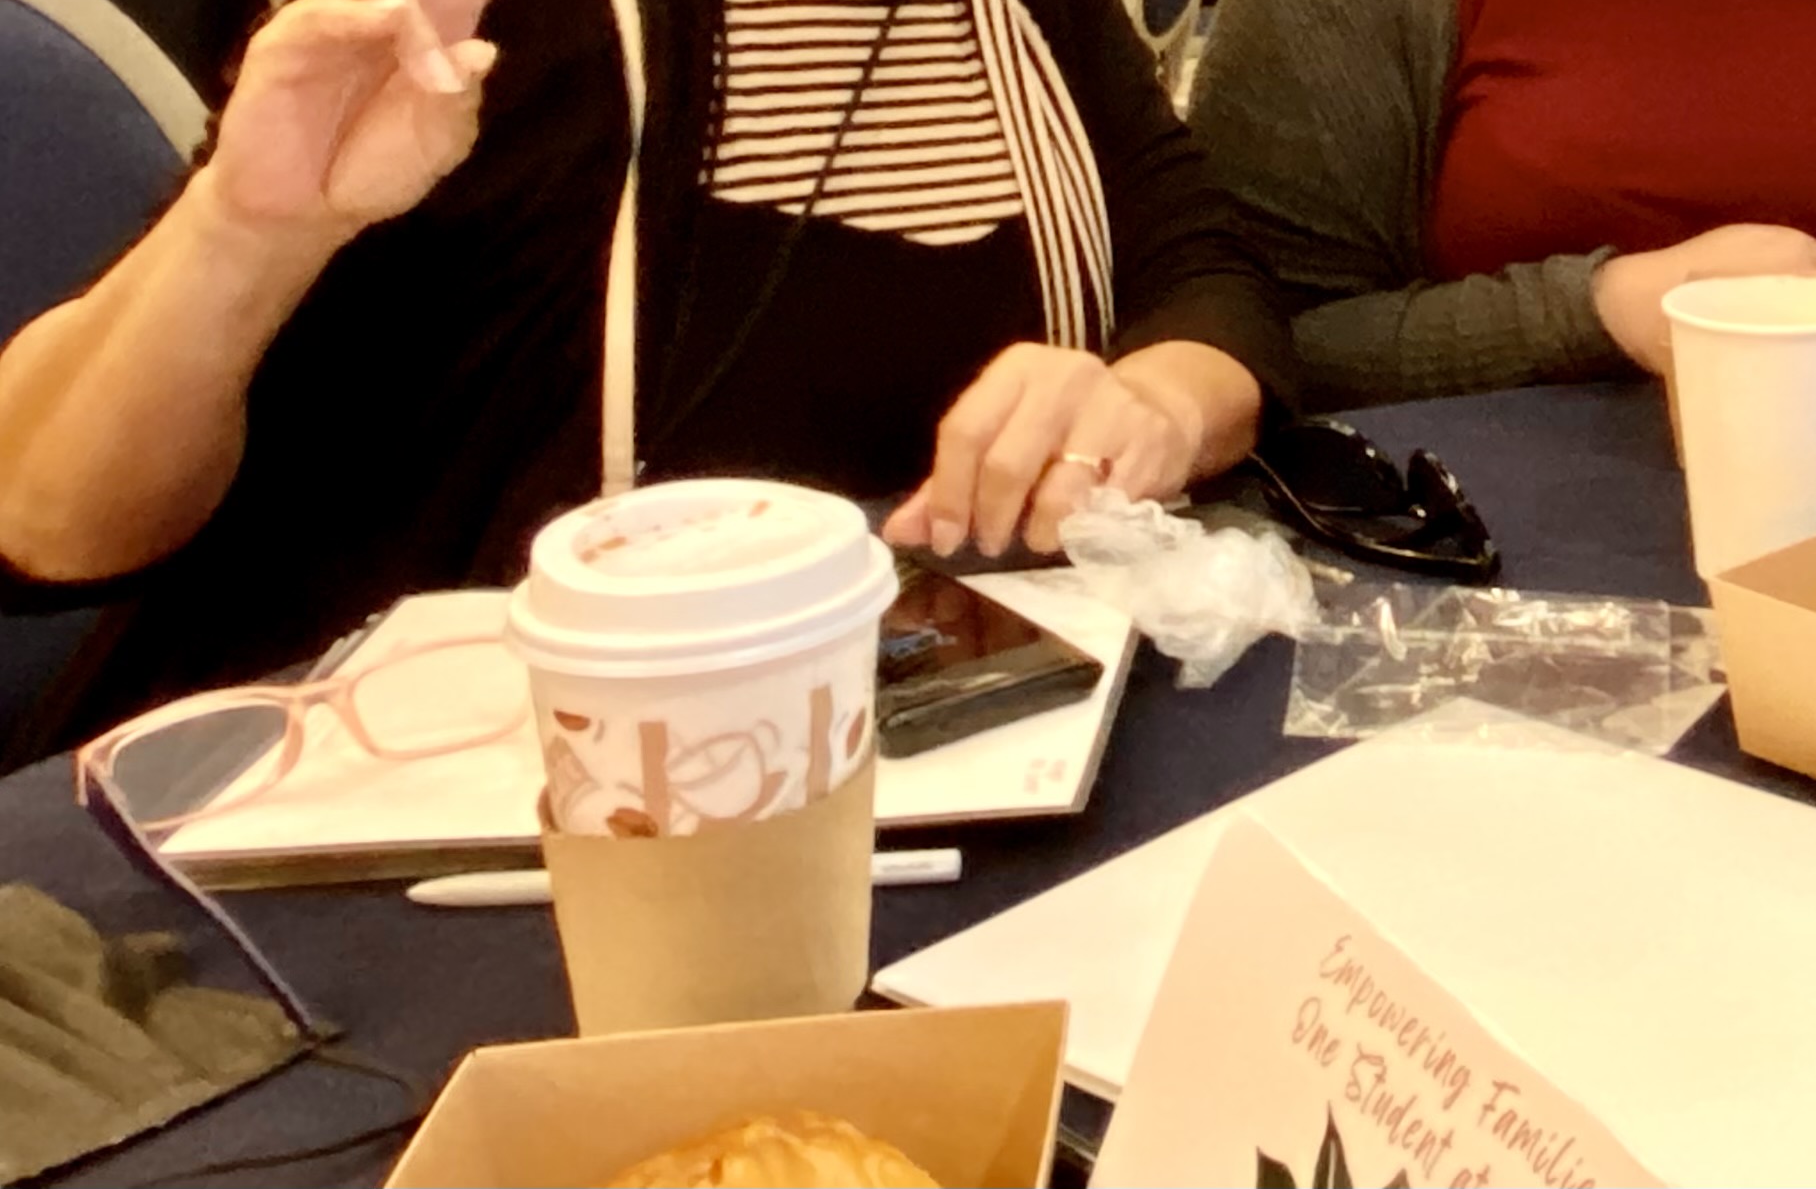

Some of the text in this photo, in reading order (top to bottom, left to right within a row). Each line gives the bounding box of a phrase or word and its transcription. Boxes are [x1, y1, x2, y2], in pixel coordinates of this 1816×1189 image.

[1292, 996, 1341, 1068] One
[1345, 1042, 1454, 1180] Student
[1320, 934, 1471, 1110] Empowering
